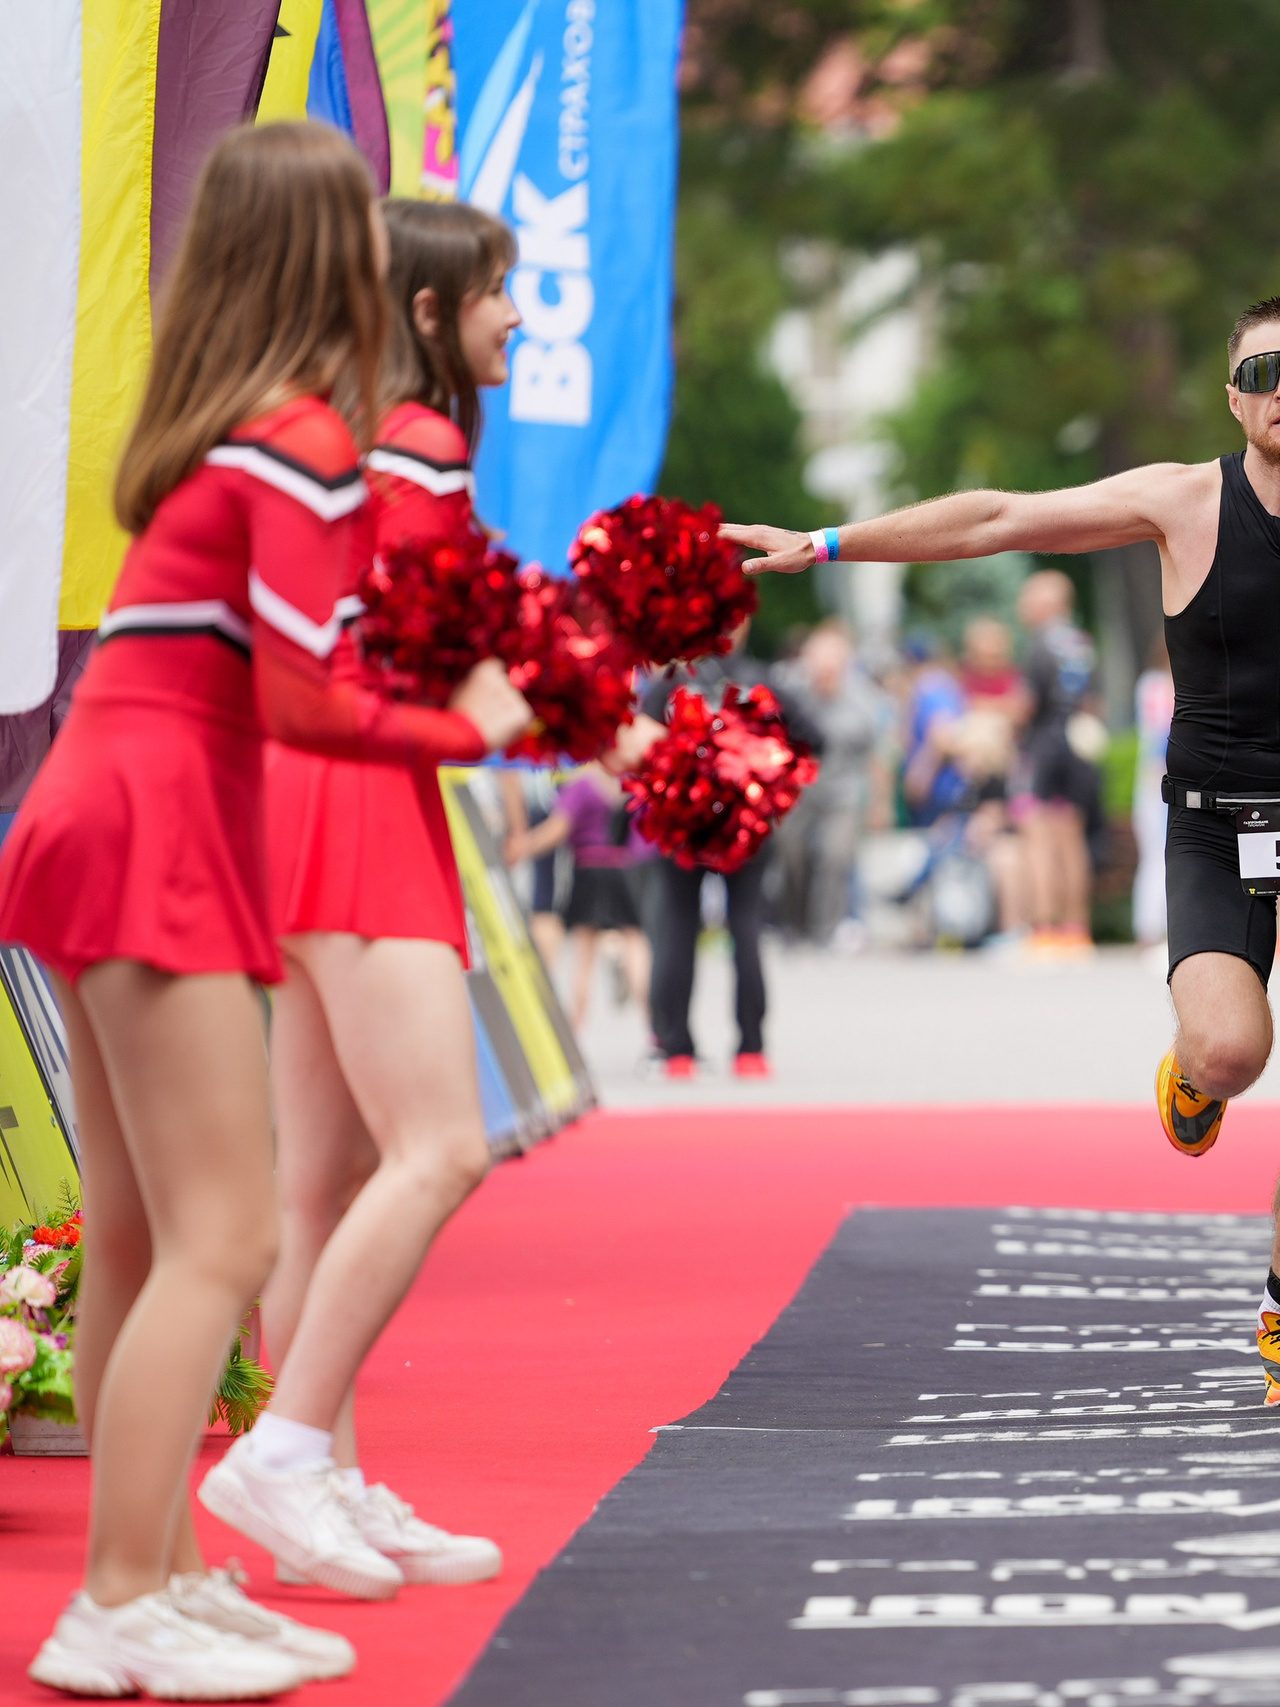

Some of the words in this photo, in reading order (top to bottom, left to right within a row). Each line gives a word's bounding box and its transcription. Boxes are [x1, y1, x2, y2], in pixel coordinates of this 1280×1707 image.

[510, 173, 594, 426] ВСК
[955, 1338, 1251, 1349] IRON
[902, 1400, 1234, 1420] IRON
[887, 1424, 1233, 1444] IRON
[851, 1489, 1242, 1513] IRON
[802, 1591, 1249, 1618] IRON
